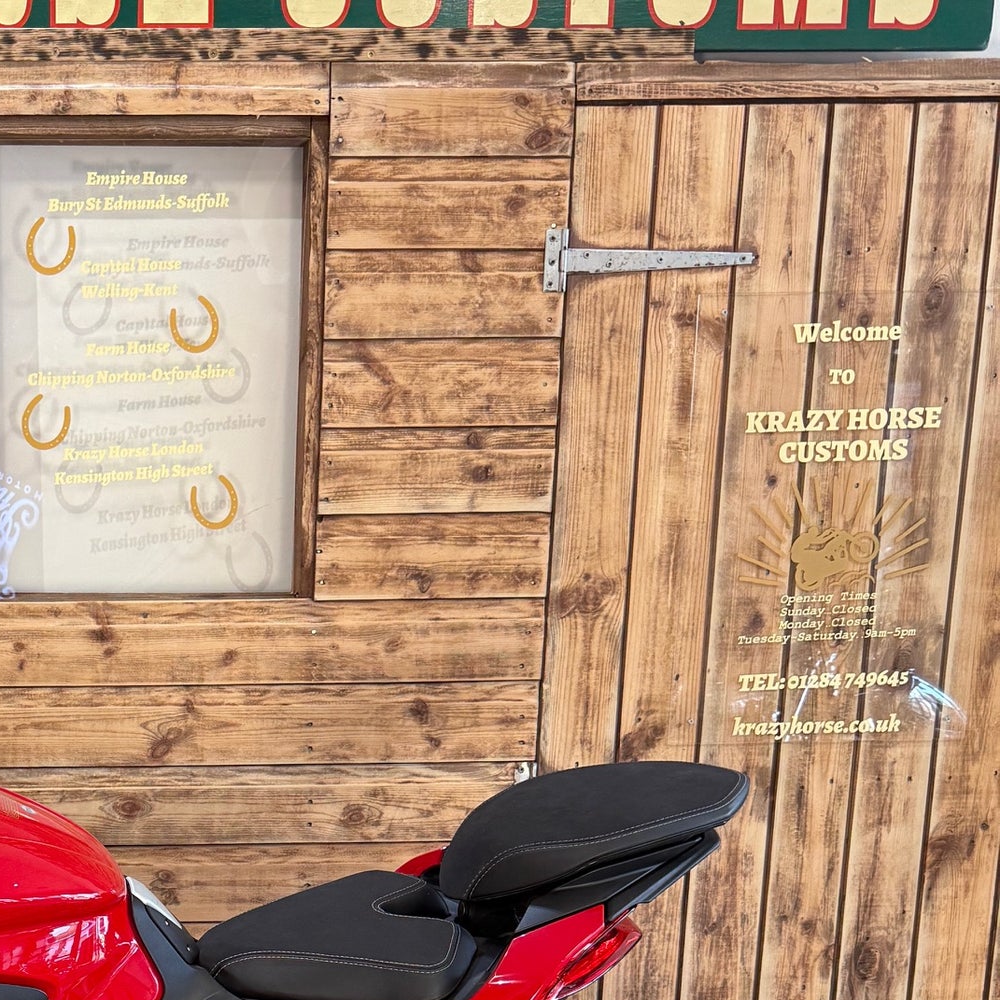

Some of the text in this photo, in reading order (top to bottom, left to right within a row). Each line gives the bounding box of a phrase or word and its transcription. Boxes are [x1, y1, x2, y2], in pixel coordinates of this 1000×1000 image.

[86, 170, 188, 190] Empire House
[47, 192, 230, 215] Bury St Edmunds-Suffolk
[136, 258, 182, 272] House
[793, 320, 903, 344] Welcome
[85, 342, 126, 357] Farm
[126, 340, 170, 355] House
[28, 365, 236, 391] Chipping Norton-Oxfordshire
[829, 368, 855, 385] TO
[745, 406, 943, 434] KRAZY HORSE
[63, 440, 204, 462] Krazy Horse London
[778, 438, 909, 464] CUSTOMS
[54, 462, 214, 486] Kensington High Street
[780, 590, 878, 606] Opening Times
[780, 603, 878, 617] Sunday Closed
[778, 616, 877, 630] Monday Closed
[844, 670, 910, 688] 749645
[732, 714, 902, 740] krazyhorse.co.uk
